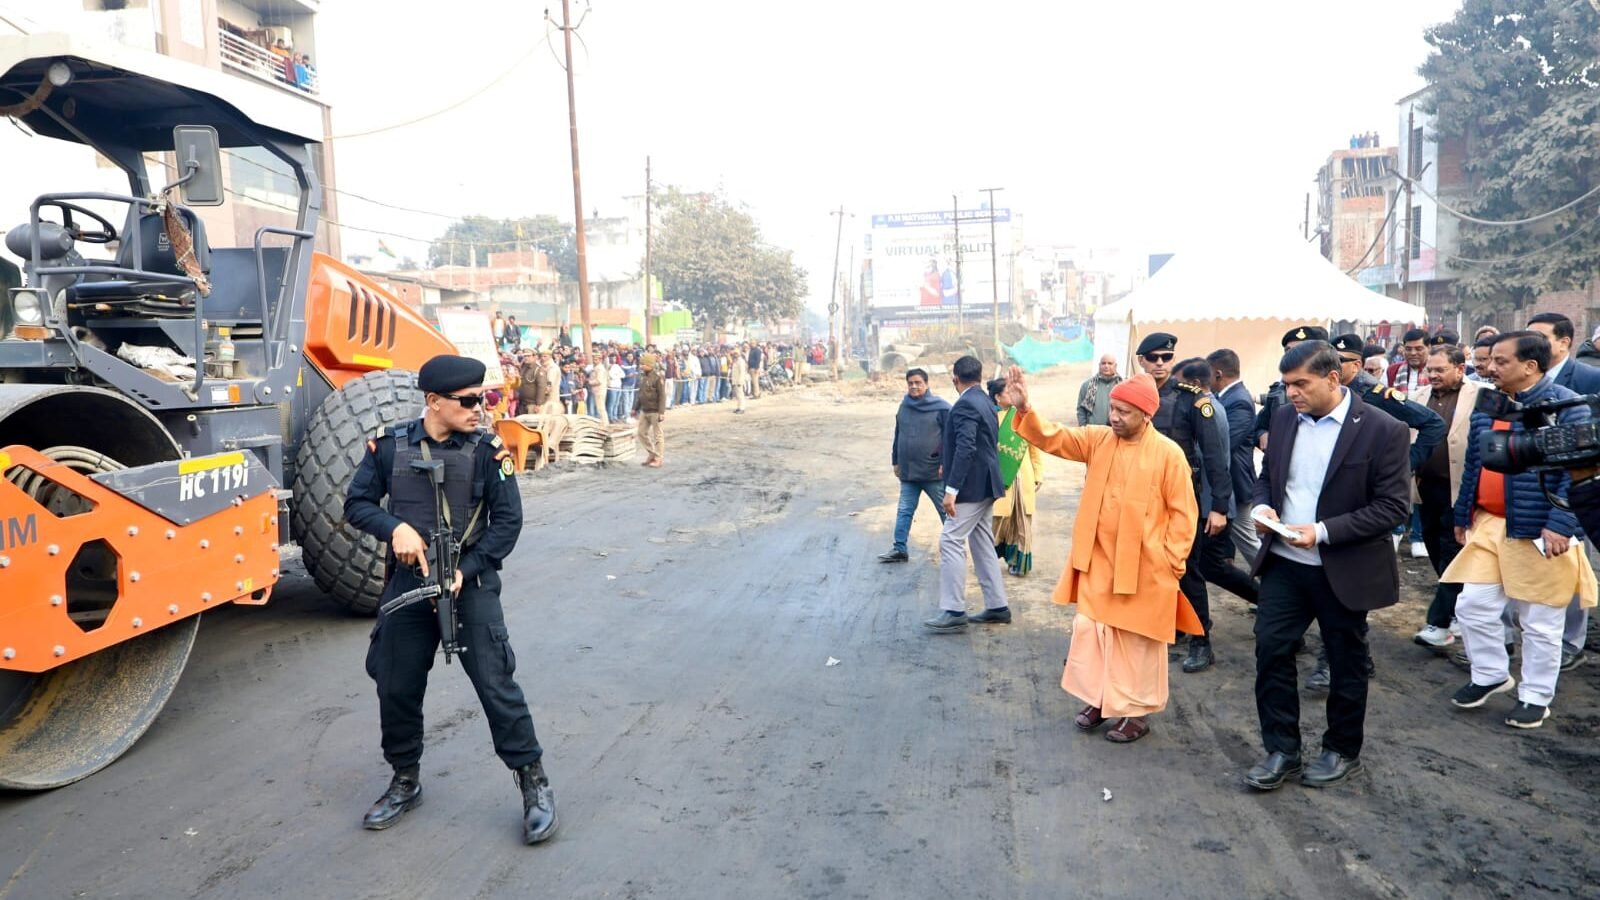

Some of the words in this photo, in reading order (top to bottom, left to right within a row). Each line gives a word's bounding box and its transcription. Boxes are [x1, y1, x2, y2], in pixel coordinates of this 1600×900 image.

[885, 244, 939, 257] VIRTUAL
[179, 470, 206, 502] HC
[210, 459, 249, 494] 119i
